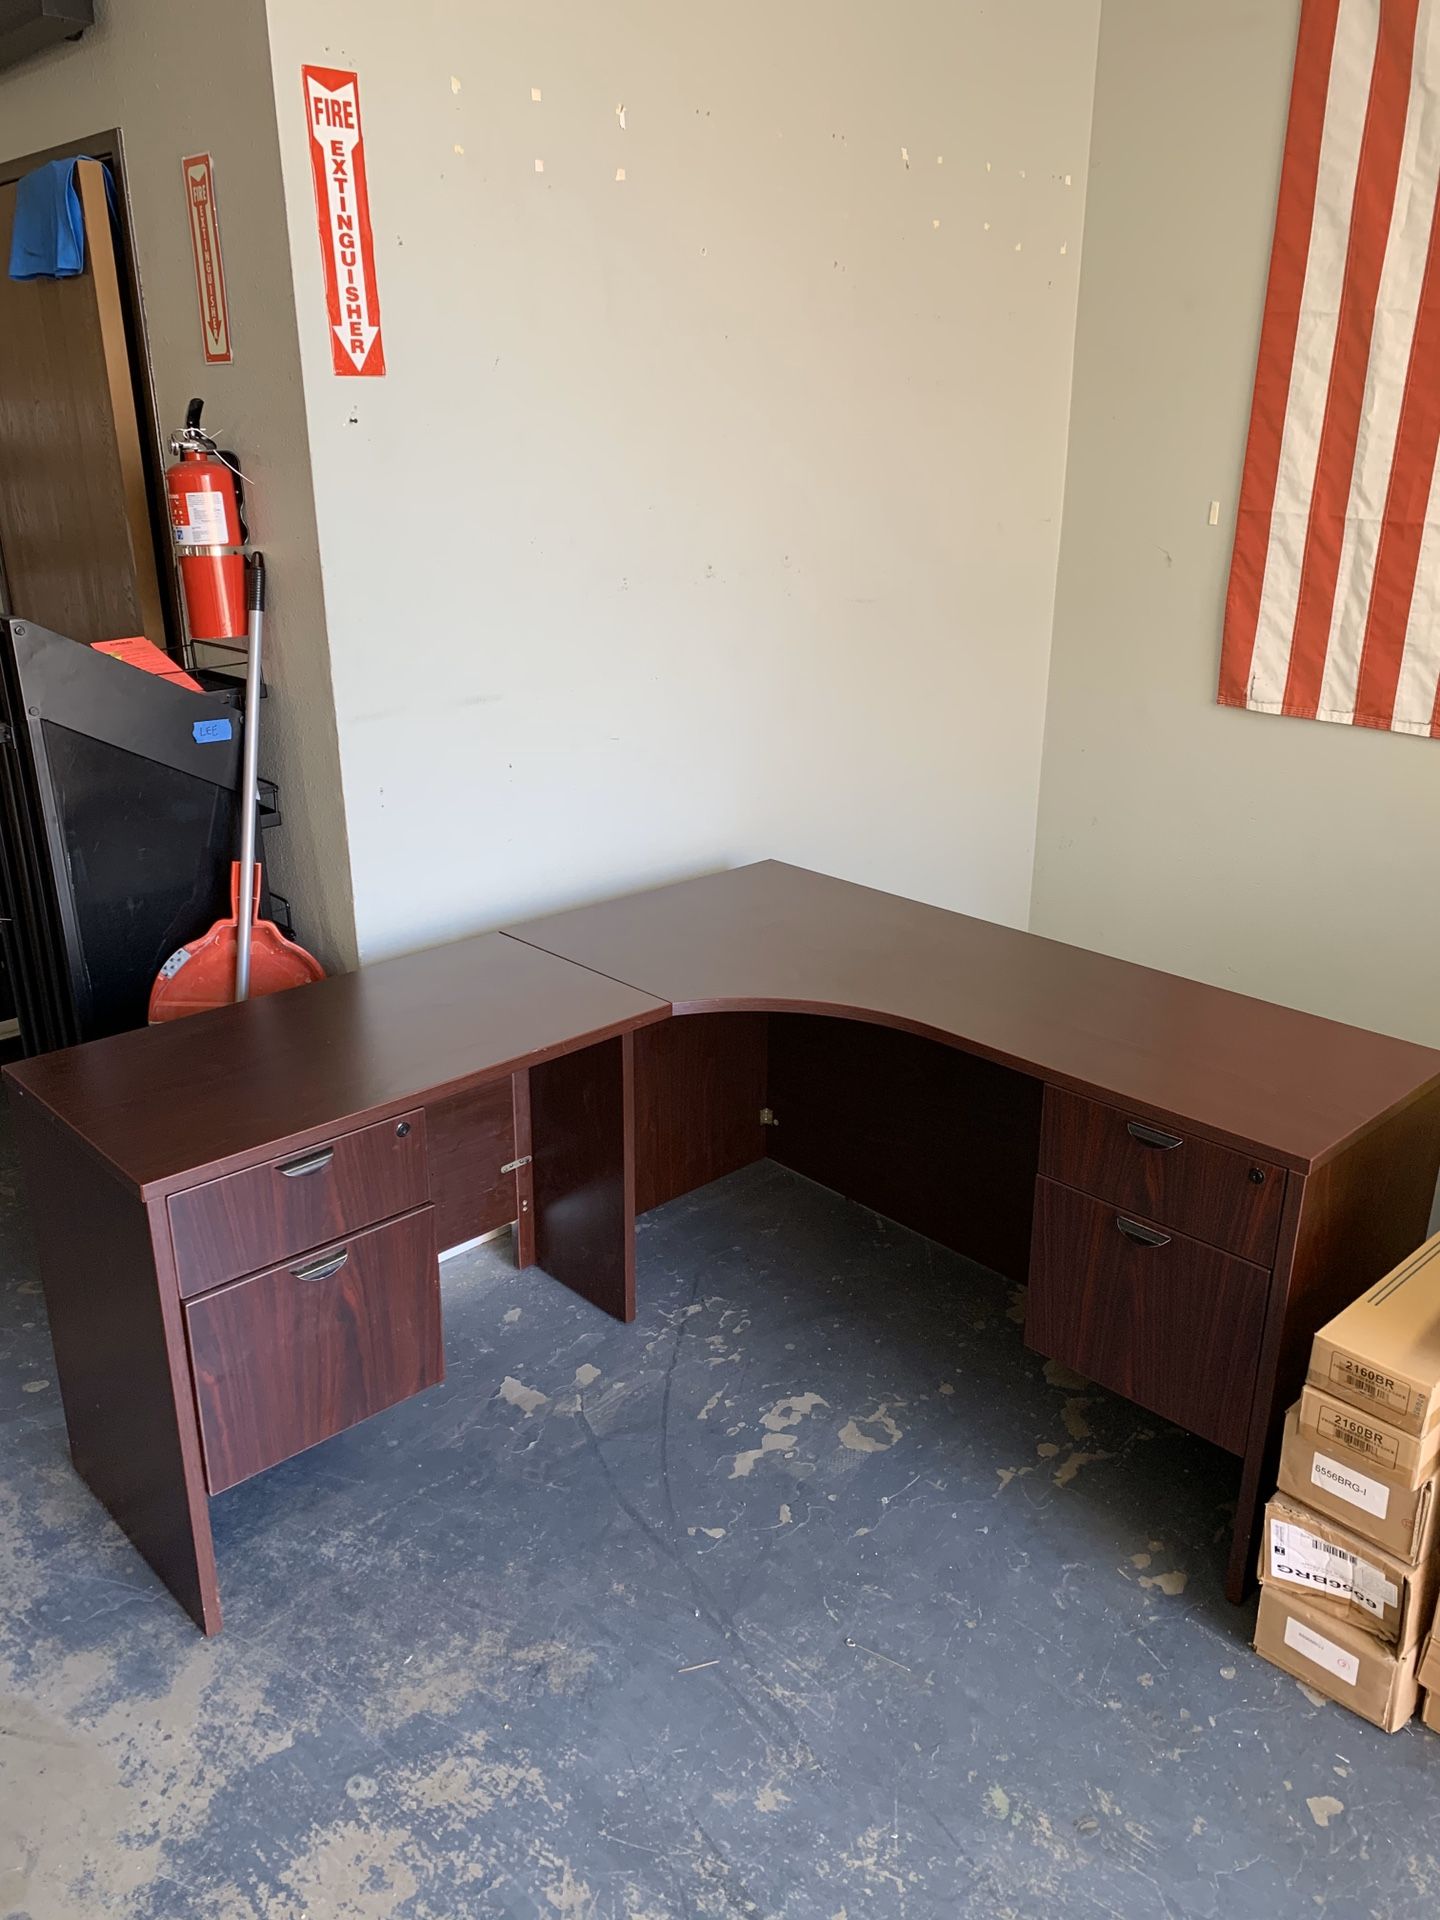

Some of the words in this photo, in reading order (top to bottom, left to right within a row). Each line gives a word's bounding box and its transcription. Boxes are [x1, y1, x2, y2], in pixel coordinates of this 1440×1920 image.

[313, 96, 355, 130] FIRE
[192, 184, 207, 201] FIRE
[330, 139, 365, 355] EXTINGUISHER
[199, 205, 219, 341] EXTINGUISHER
[200, 724, 218, 737] LEE
[1345, 1360, 1395, 1390] 2160BR
[1334, 1414, 1383, 1445] 2160BR
[1276, 1564, 1377, 1609] 6556BRG
